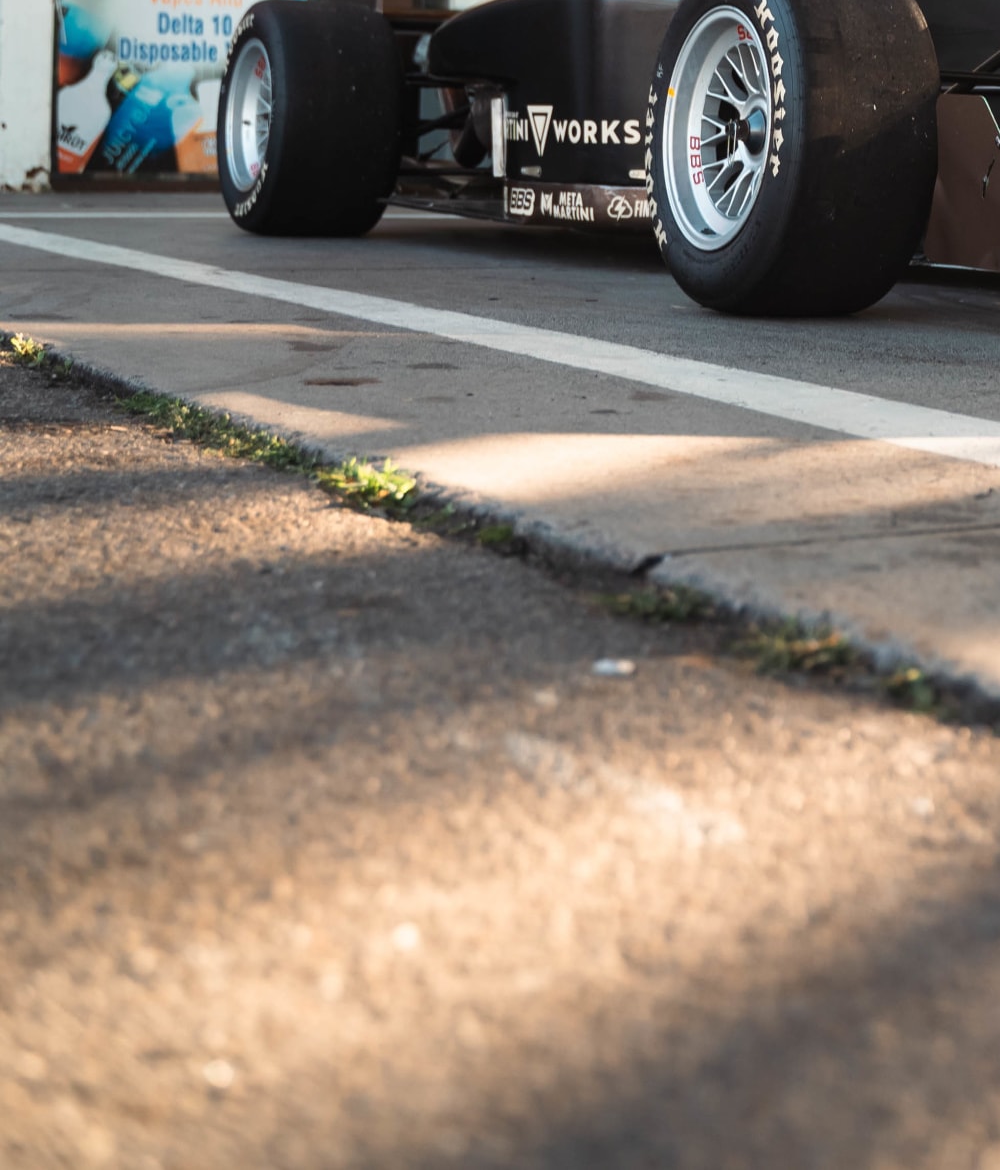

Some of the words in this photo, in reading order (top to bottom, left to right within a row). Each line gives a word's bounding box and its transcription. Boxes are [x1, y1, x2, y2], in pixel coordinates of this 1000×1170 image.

[157, 11, 204, 36] Delta
[212, 15, 233, 37] 10
[118, 36, 219, 64] Disposable
[553, 119, 641, 145] WORKS
[690, 135, 704, 185] BBS
[510, 188, 535, 215] BBS
[559, 191, 583, 207] META
[553, 205, 595, 222] MARTINI
